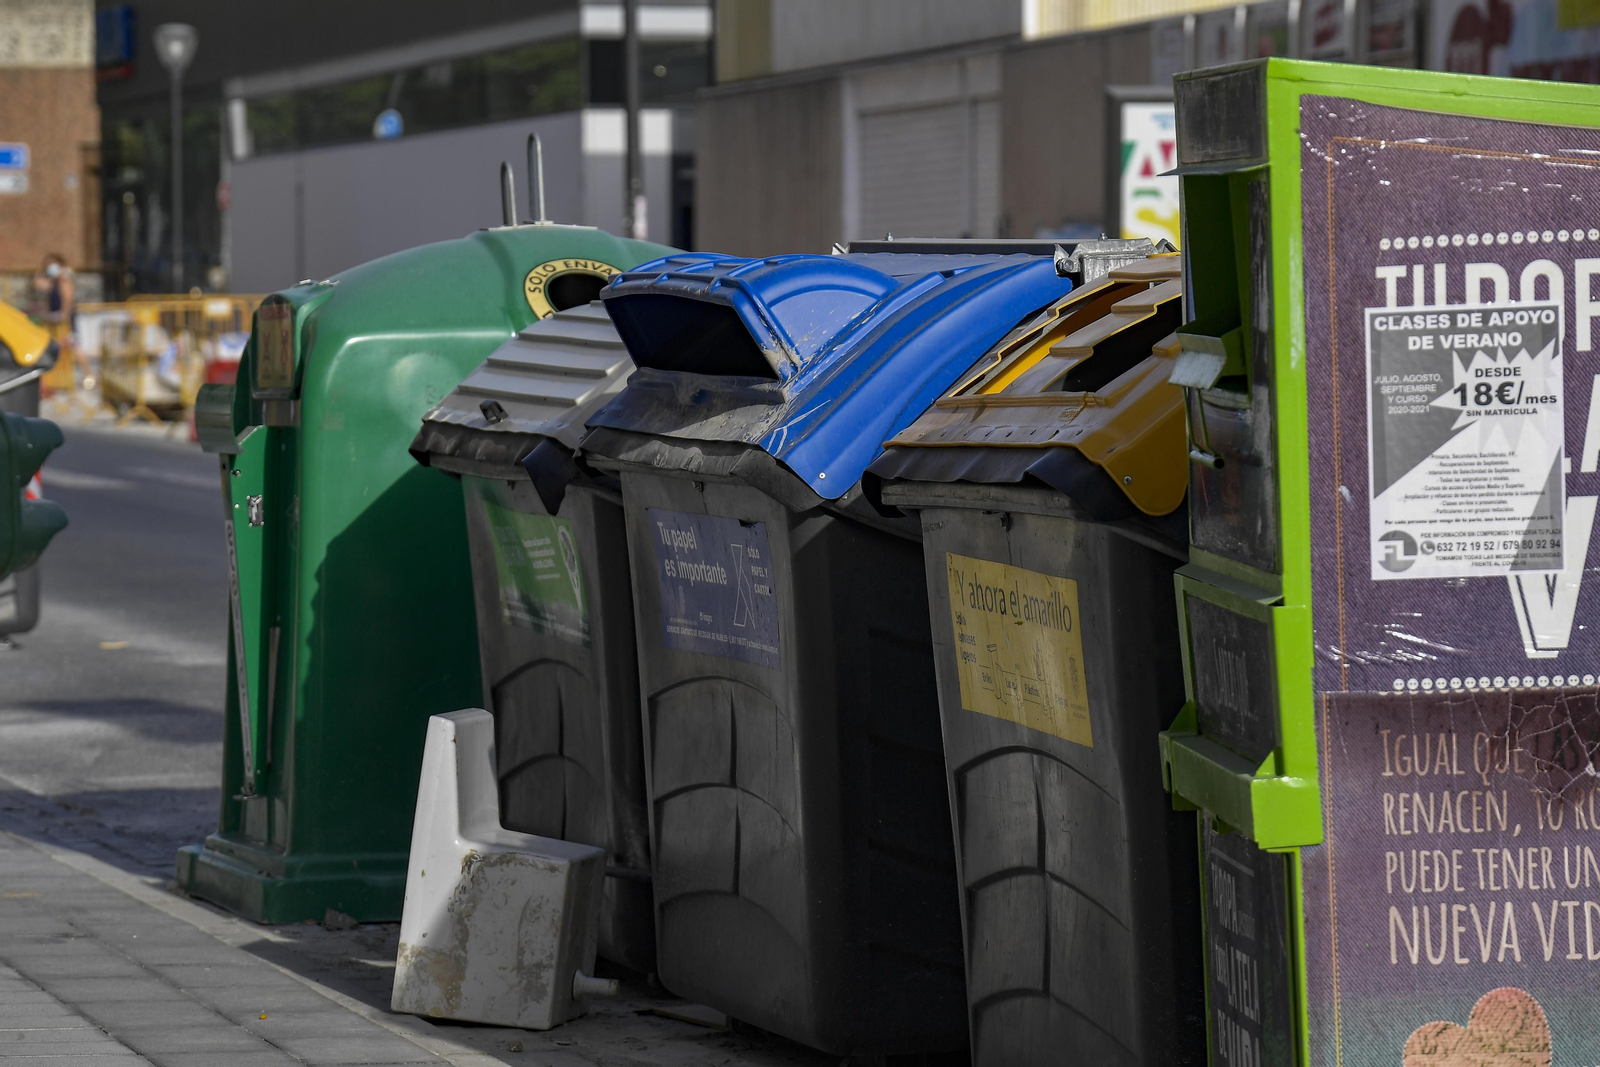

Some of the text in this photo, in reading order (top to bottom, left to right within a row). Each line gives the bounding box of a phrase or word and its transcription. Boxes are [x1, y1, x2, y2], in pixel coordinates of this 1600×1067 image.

[528, 264, 556, 294] SOLO
[1374, 310, 1556, 331] CLASES DE APOYO
[1408, 332, 1522, 350] DE VERANO
[1475, 366, 1522, 378] DESDE
[1380, 384, 1437, 394] SEPTIEMBRE
[1396, 394, 1428, 404] CURSO
[1388, 404, 1430, 414] 2020-2021
[1466, 409, 1482, 417] SIN
[656, 521, 697, 554] Tu papel
[1436, 542, 1453, 552] 632
[1456, 542, 1467, 551] 72
[1470, 542, 1481, 551] 19
[1484, 541, 1494, 550] 52
[1502, 540, 1520, 550] 679
[1522, 540, 1533, 550] 80
[1536, 539, 1547, 549] 92
[1550, 538, 1561, 548] 94
[665, 555, 728, 587] es importante
[956, 570, 1072, 632] Y ahora el amarillo
[1381, 728, 1466, 778] IGUAL
[1474, 730, 1526, 786] QUE
[1382, 790, 1522, 837] RENACEN,
[1385, 848, 1466, 894] PUEDE
[1472, 846, 1556, 892] TENER
[1218, 868, 1238, 934] ROPA
[1389, 901, 1522, 966] NUEVA
[1236, 949, 1260, 1024] TELA
